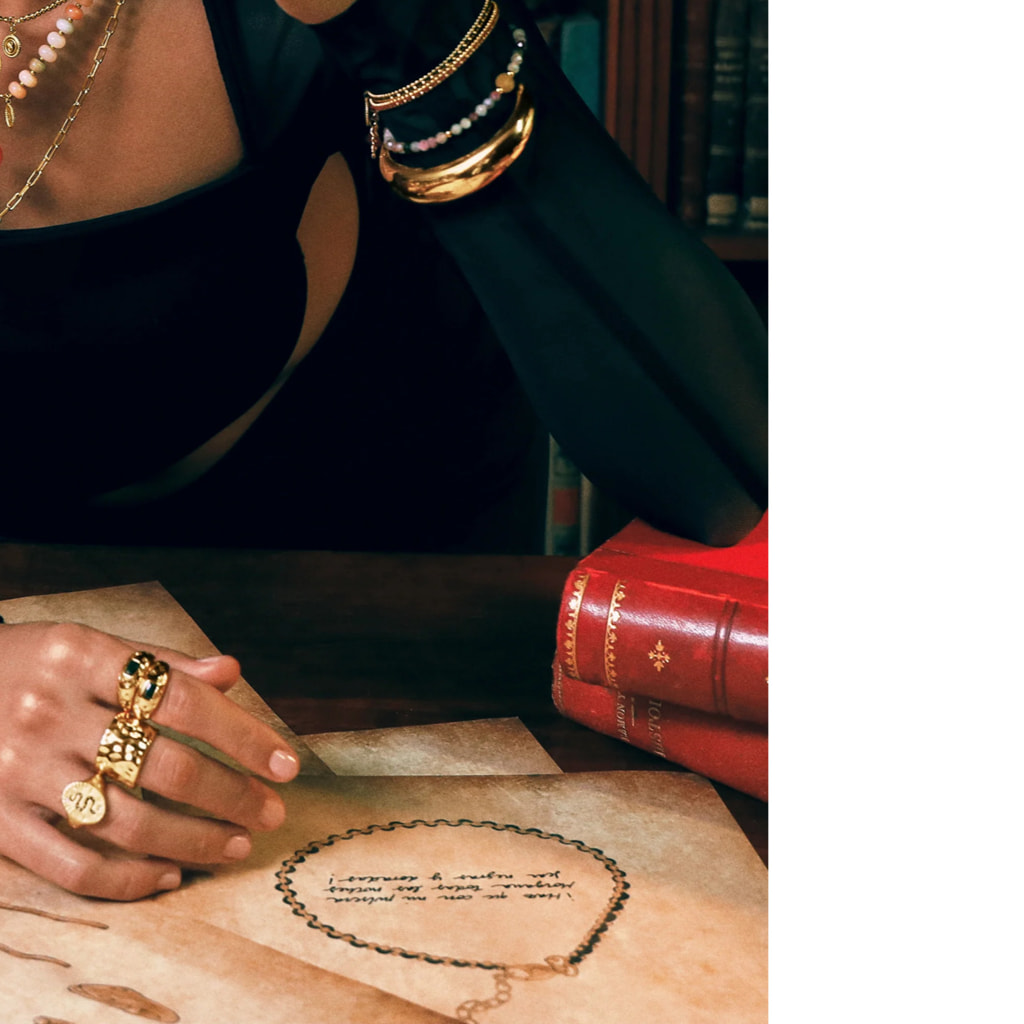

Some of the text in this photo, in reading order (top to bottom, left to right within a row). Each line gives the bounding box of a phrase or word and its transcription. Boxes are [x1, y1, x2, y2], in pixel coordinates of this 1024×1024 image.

[427, 872, 443, 882] y
[453, 871, 515, 882] negras
[322, 880, 575, 895] Morgana todas las noches
[326, 894, 396, 906] pulsera
[401, 895, 427, 905] mi
[482, 891, 509, 900] que
